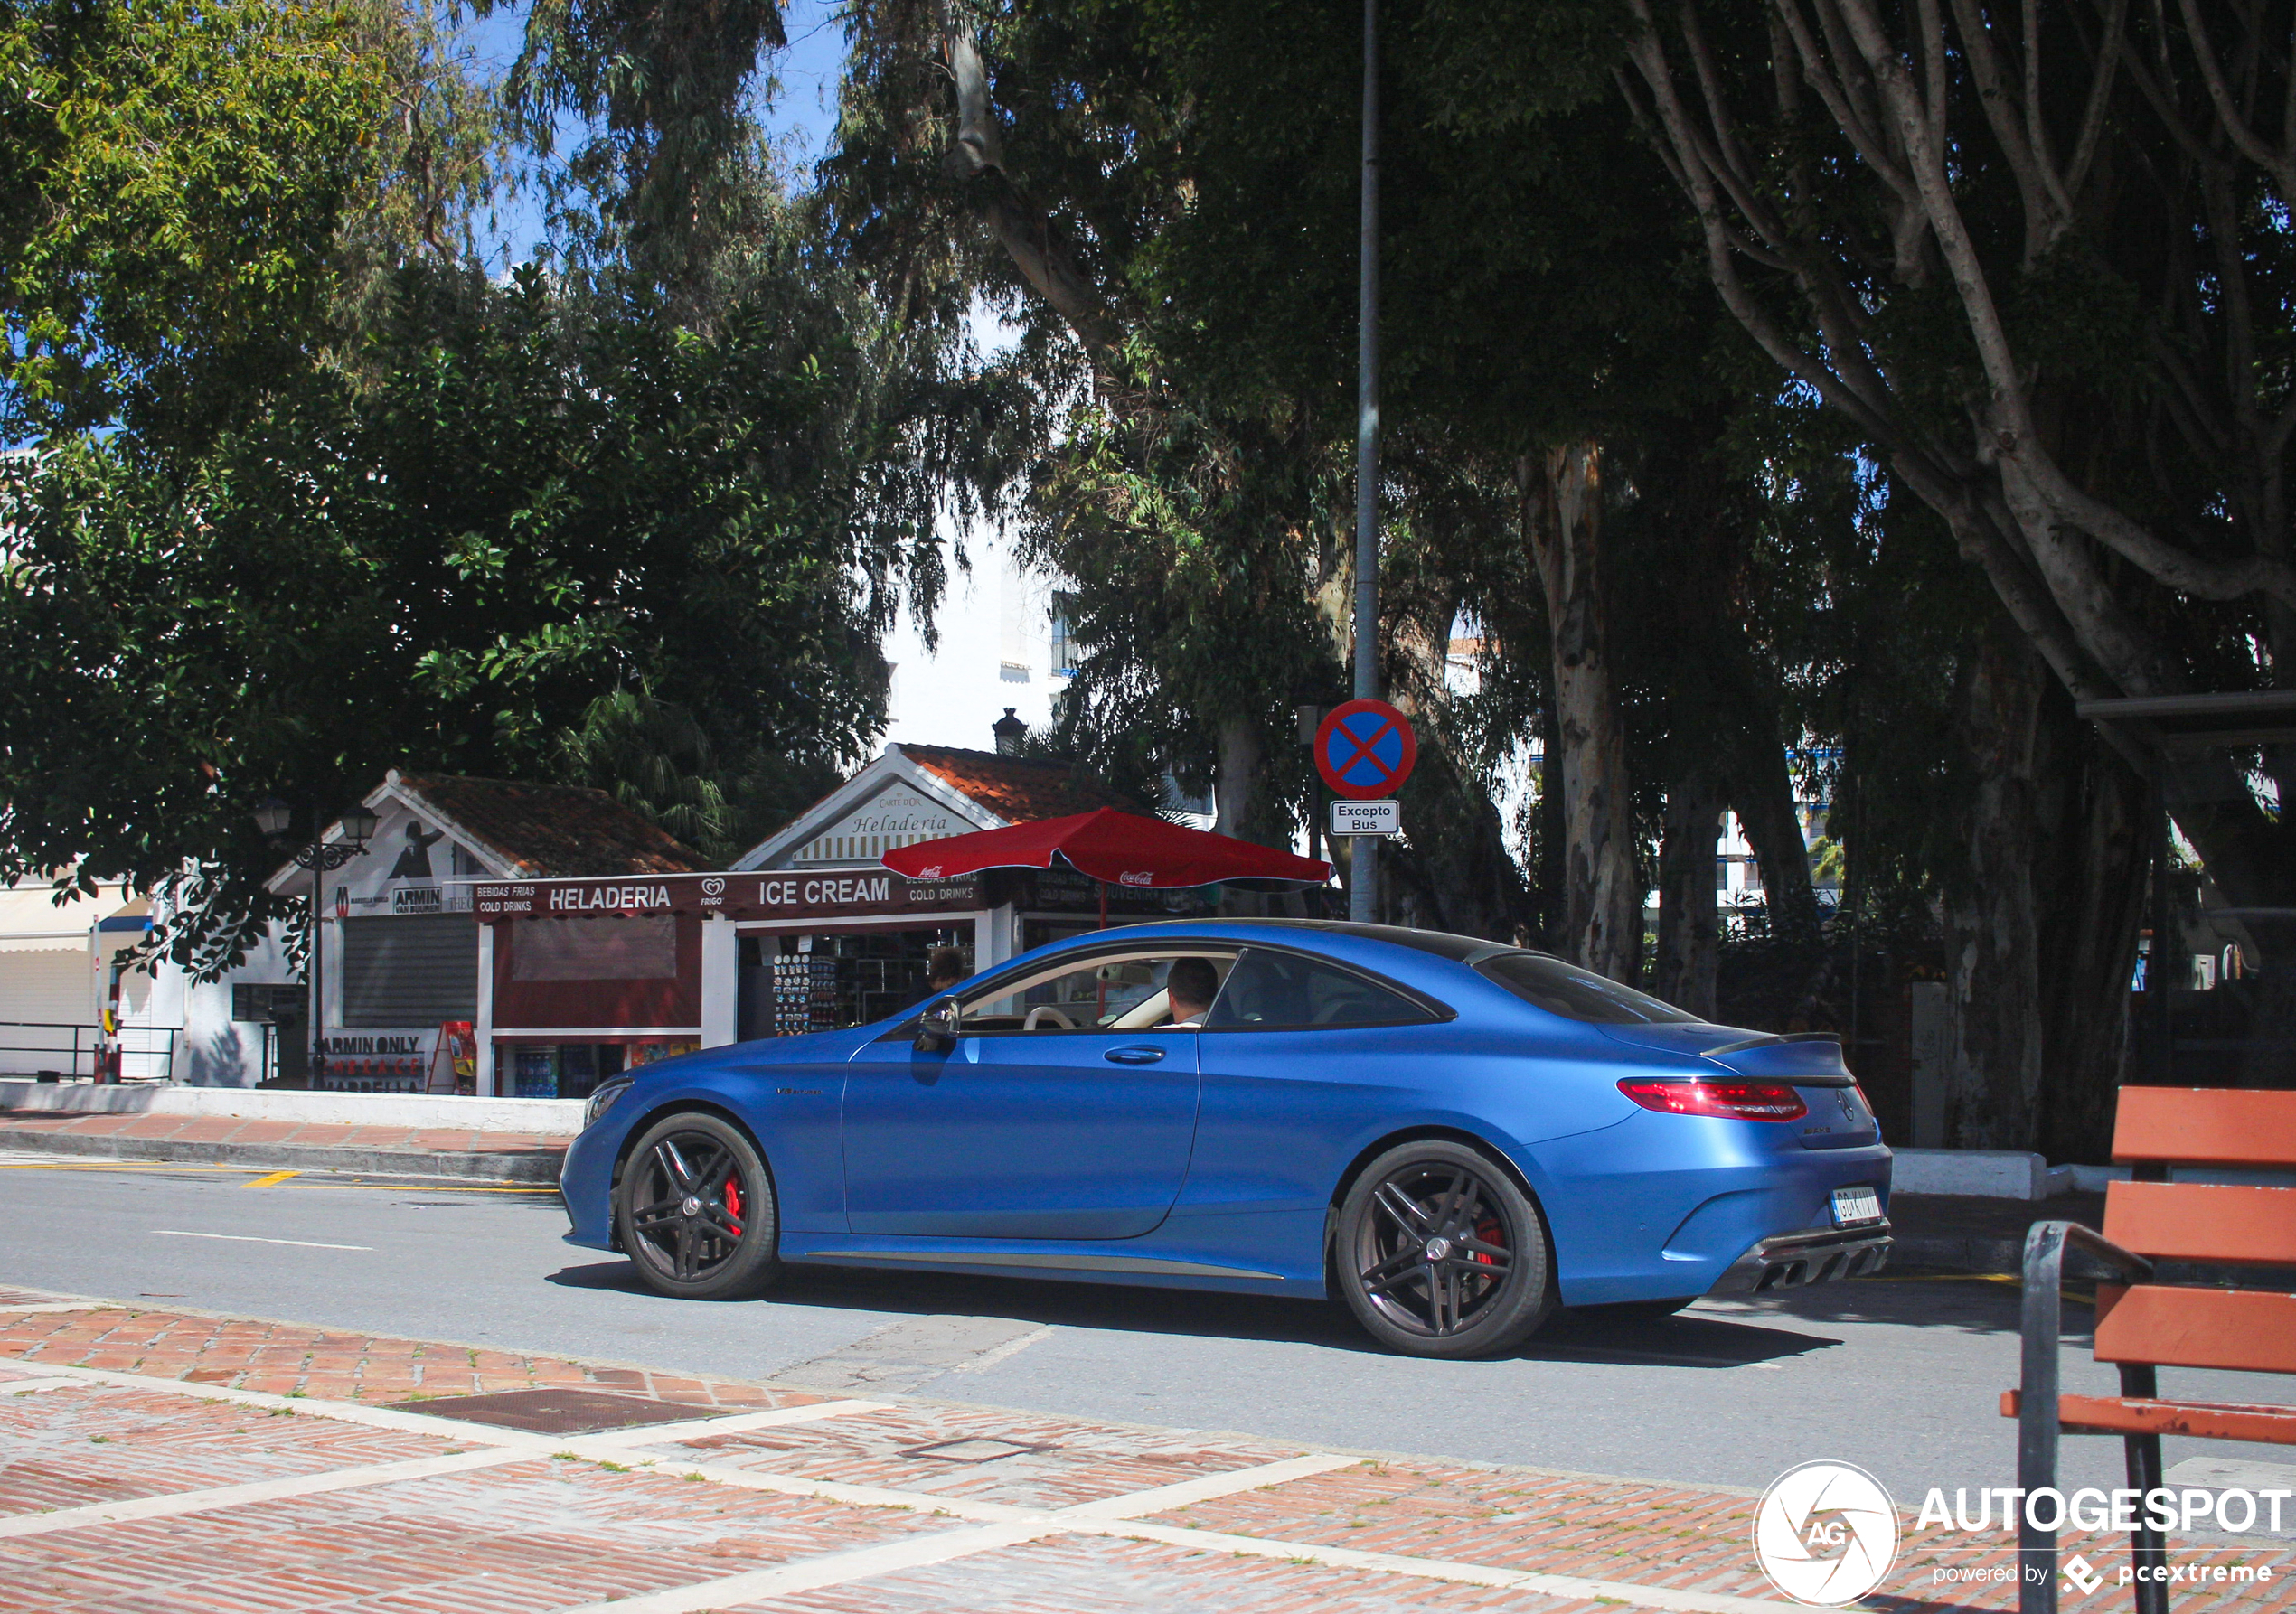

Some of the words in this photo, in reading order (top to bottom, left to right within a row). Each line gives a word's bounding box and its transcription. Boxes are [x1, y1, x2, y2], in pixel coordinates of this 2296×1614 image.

[879, 798, 901, 808] CARTE
[1338, 805, 1390, 818] Excepto
[852, 813, 947, 833] Heladería
[1351, 820, 1378, 830] Bus
[1119, 871, 1154, 885] Coca-Cola
[395, 889, 440, 905] ARMIN
[476, 887, 509, 897] BEBIDAS
[512, 886, 535, 896] FRIAS
[549, 885, 671, 910] HELADERIA
[759, 881, 797, 905] ICE
[805, 877, 889, 904] CREAM
[909, 889, 936, 901] COLD
[940, 887, 974, 900] DRINKS
[479, 902, 501, 912] COLD
[503, 901, 532, 912] DRINKS
[701, 897, 722, 906] FRIGO
[395, 906, 409, 914] VAN
[323, 1037, 373, 1054] ARMIN
[377, 1037, 419, 1054] ONLY
